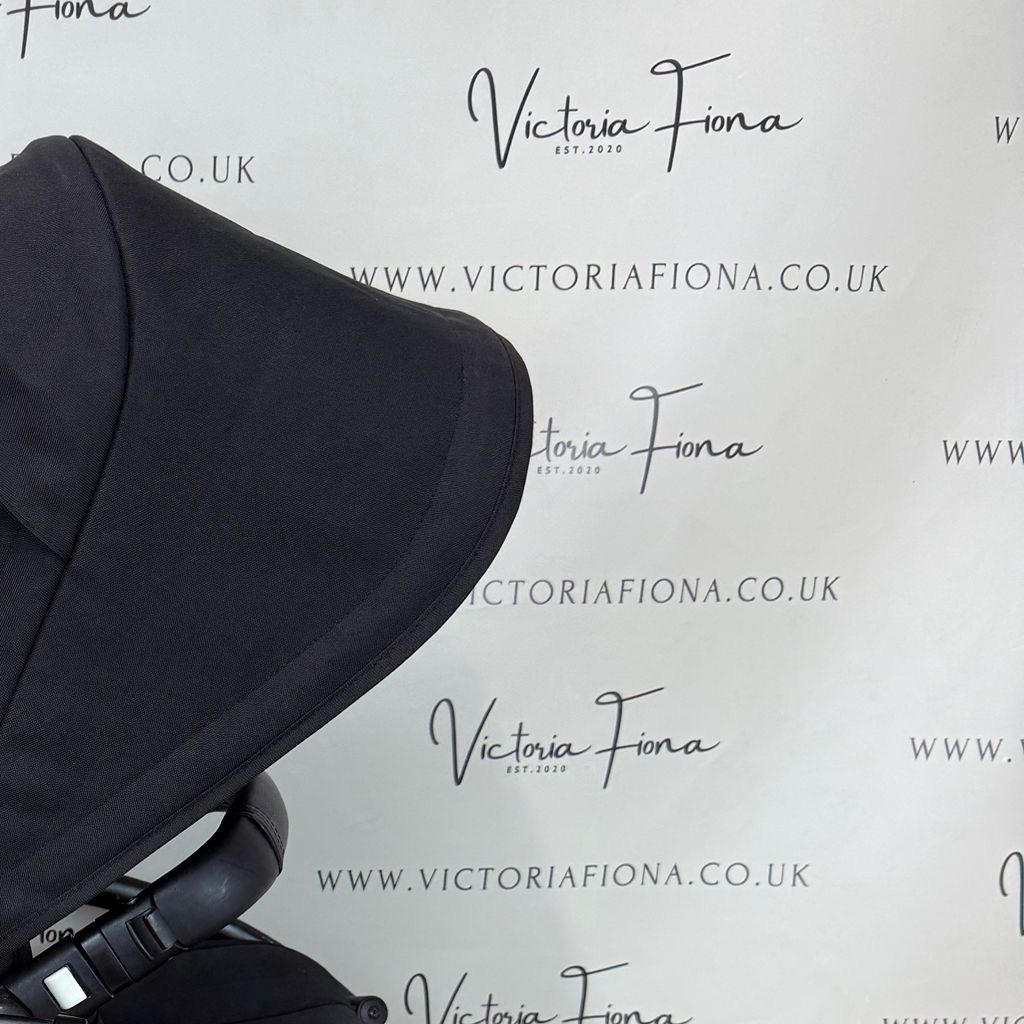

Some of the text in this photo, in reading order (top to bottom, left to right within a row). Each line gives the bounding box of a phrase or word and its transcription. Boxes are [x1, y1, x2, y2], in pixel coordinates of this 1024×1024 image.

[467, 53, 803, 173] Victoria Fiona
[555, 145, 622, 155] EST.2020
[350, 262, 888, 293] WWW.VICTORIAFIONA.CO.UK
[531, 383, 763, 495] toria Fiona
[537, 466, 600, 474] EST.2020
[470, 576, 840, 605] ICTORIAFIONA.CO.UK
[429, 687, 721, 789] Victoria Fiona
[910, 737, 1024, 763] WWW.
[507, 765, 566, 773] EST.2020
[317, 861, 811, 891] WWW.VICTORIAFIONA.CO.UK
